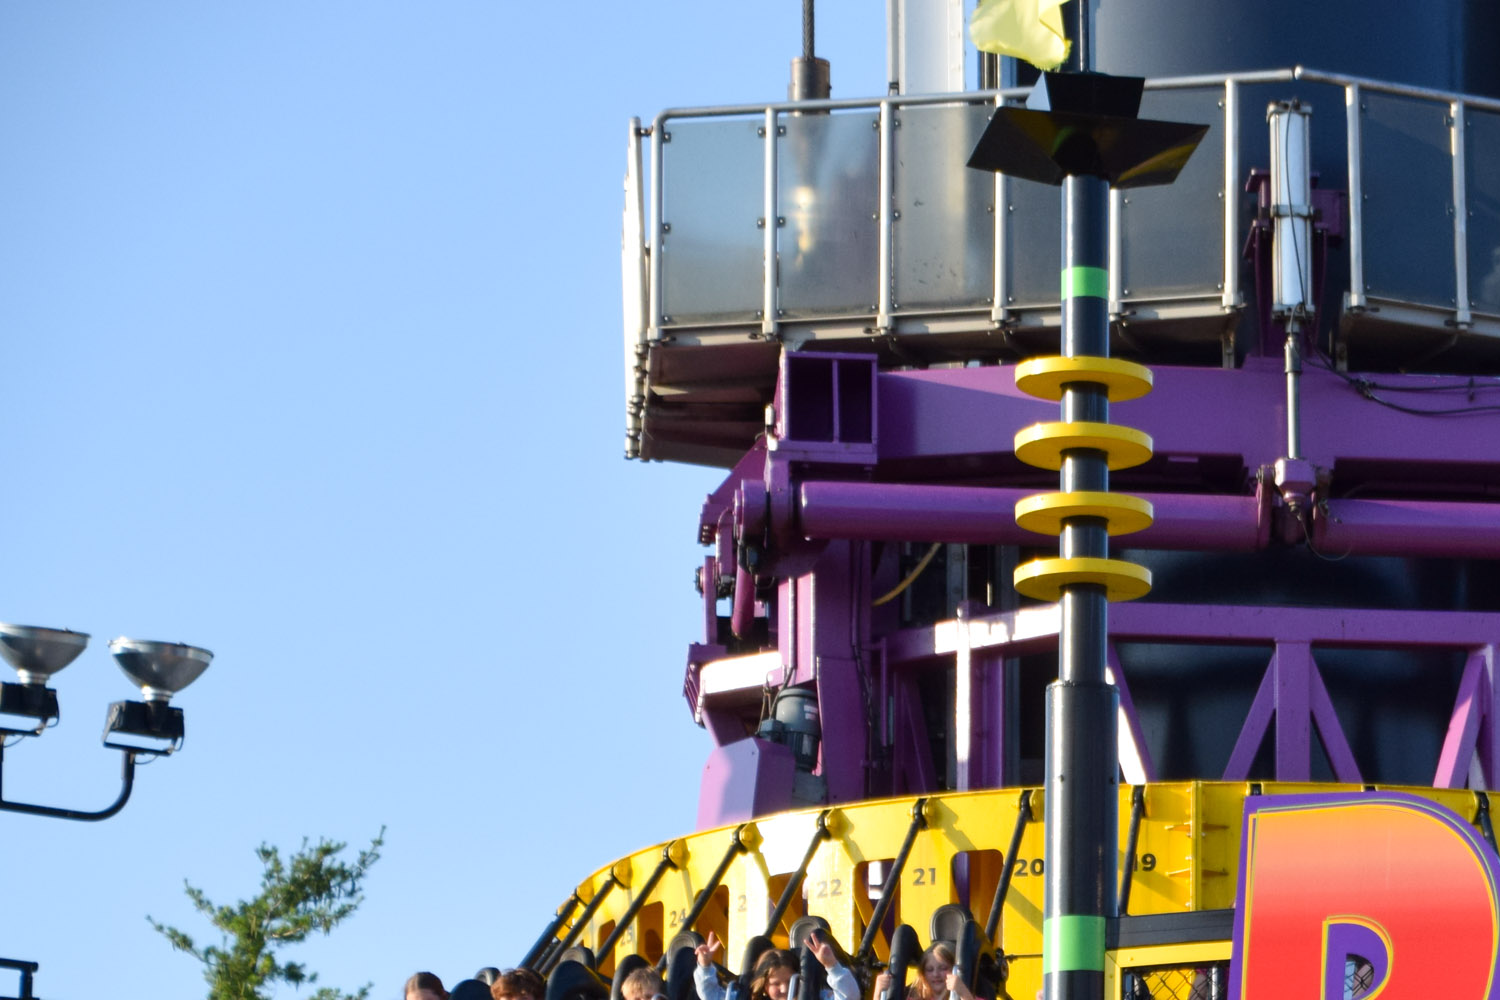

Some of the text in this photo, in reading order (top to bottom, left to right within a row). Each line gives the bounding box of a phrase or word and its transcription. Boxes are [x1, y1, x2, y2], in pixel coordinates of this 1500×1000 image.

[912, 867, 936, 886] 21
[1014, 858, 1044, 877] 20
[816, 878, 842, 898] 22
